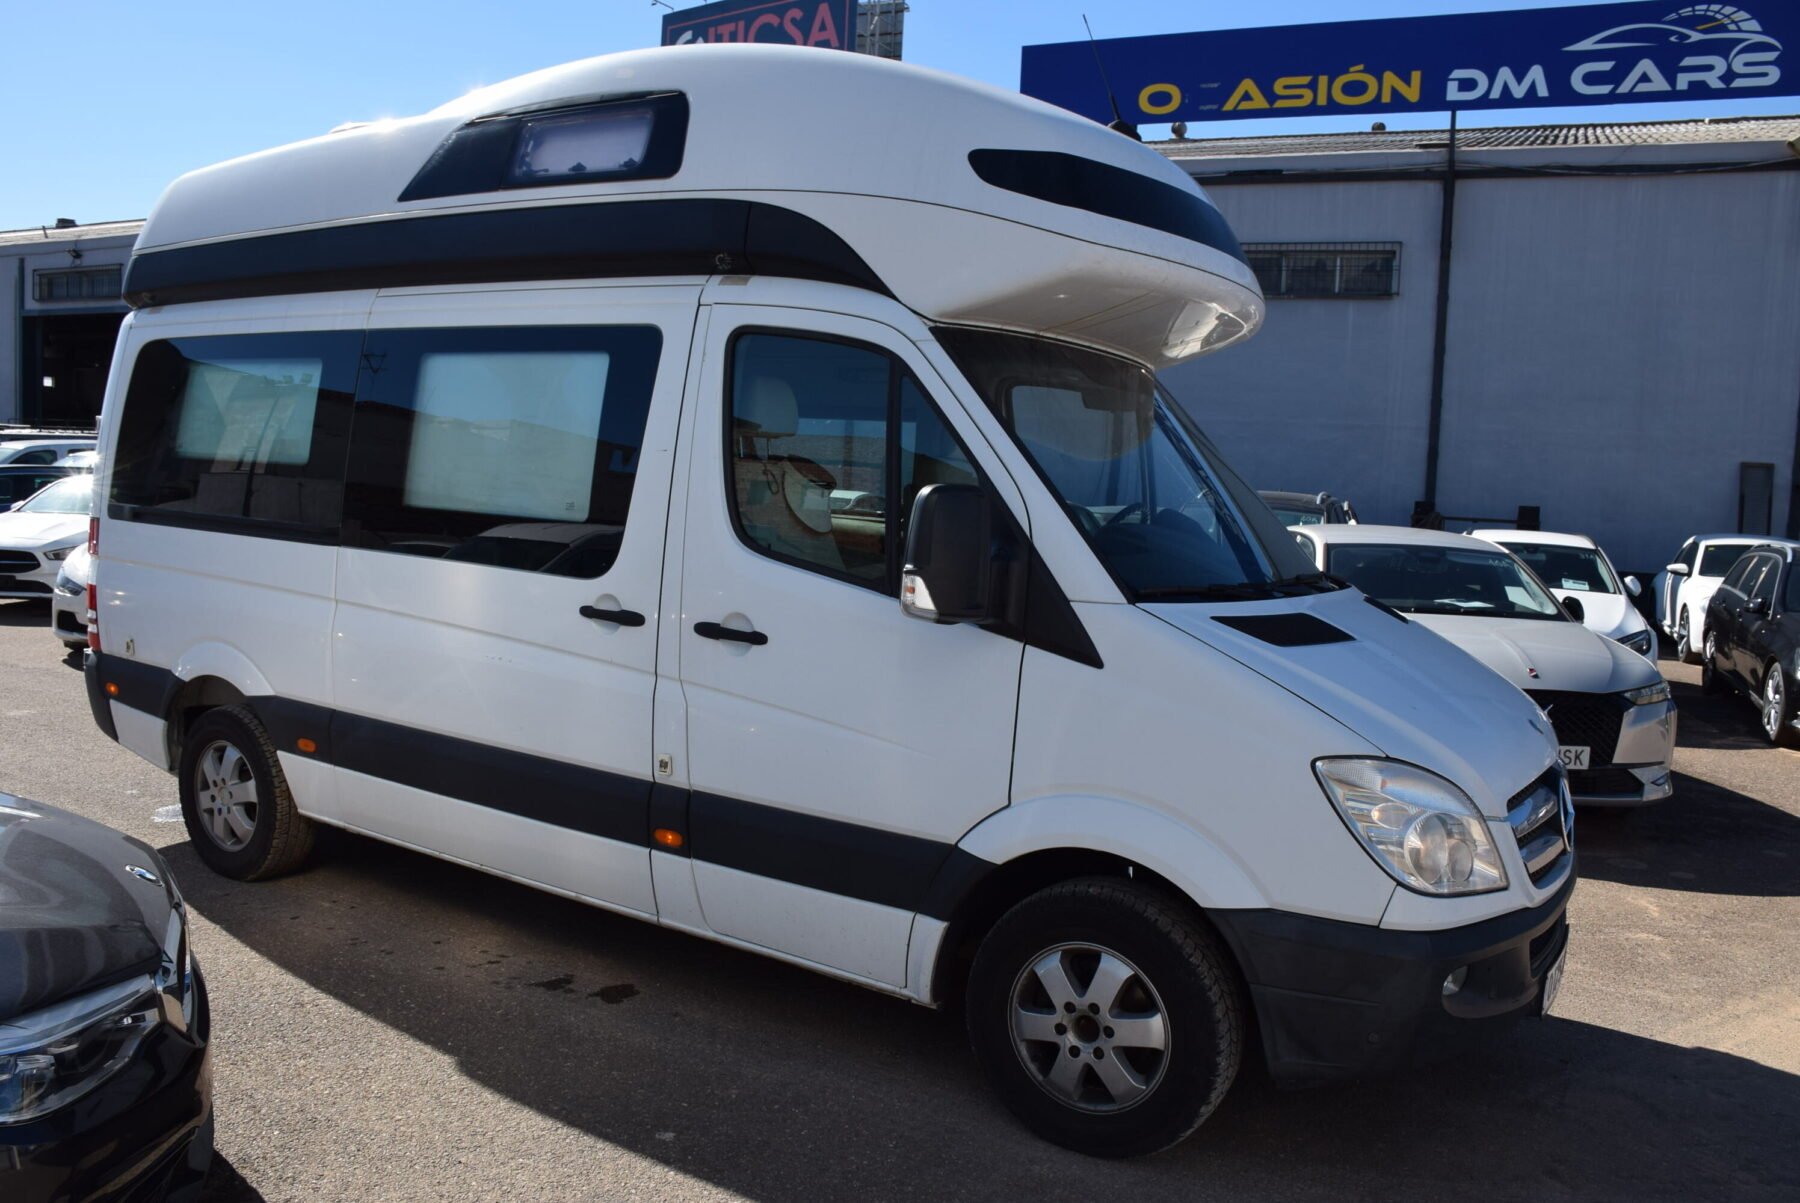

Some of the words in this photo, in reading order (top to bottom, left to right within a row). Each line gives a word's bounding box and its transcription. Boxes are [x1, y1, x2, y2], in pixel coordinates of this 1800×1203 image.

[1138, 64, 1422, 115] OASIÓN
[1446, 64, 1550, 101] DM
[1570, 51, 1782, 95] CARS
[1559, 748, 1585, 766] SK
